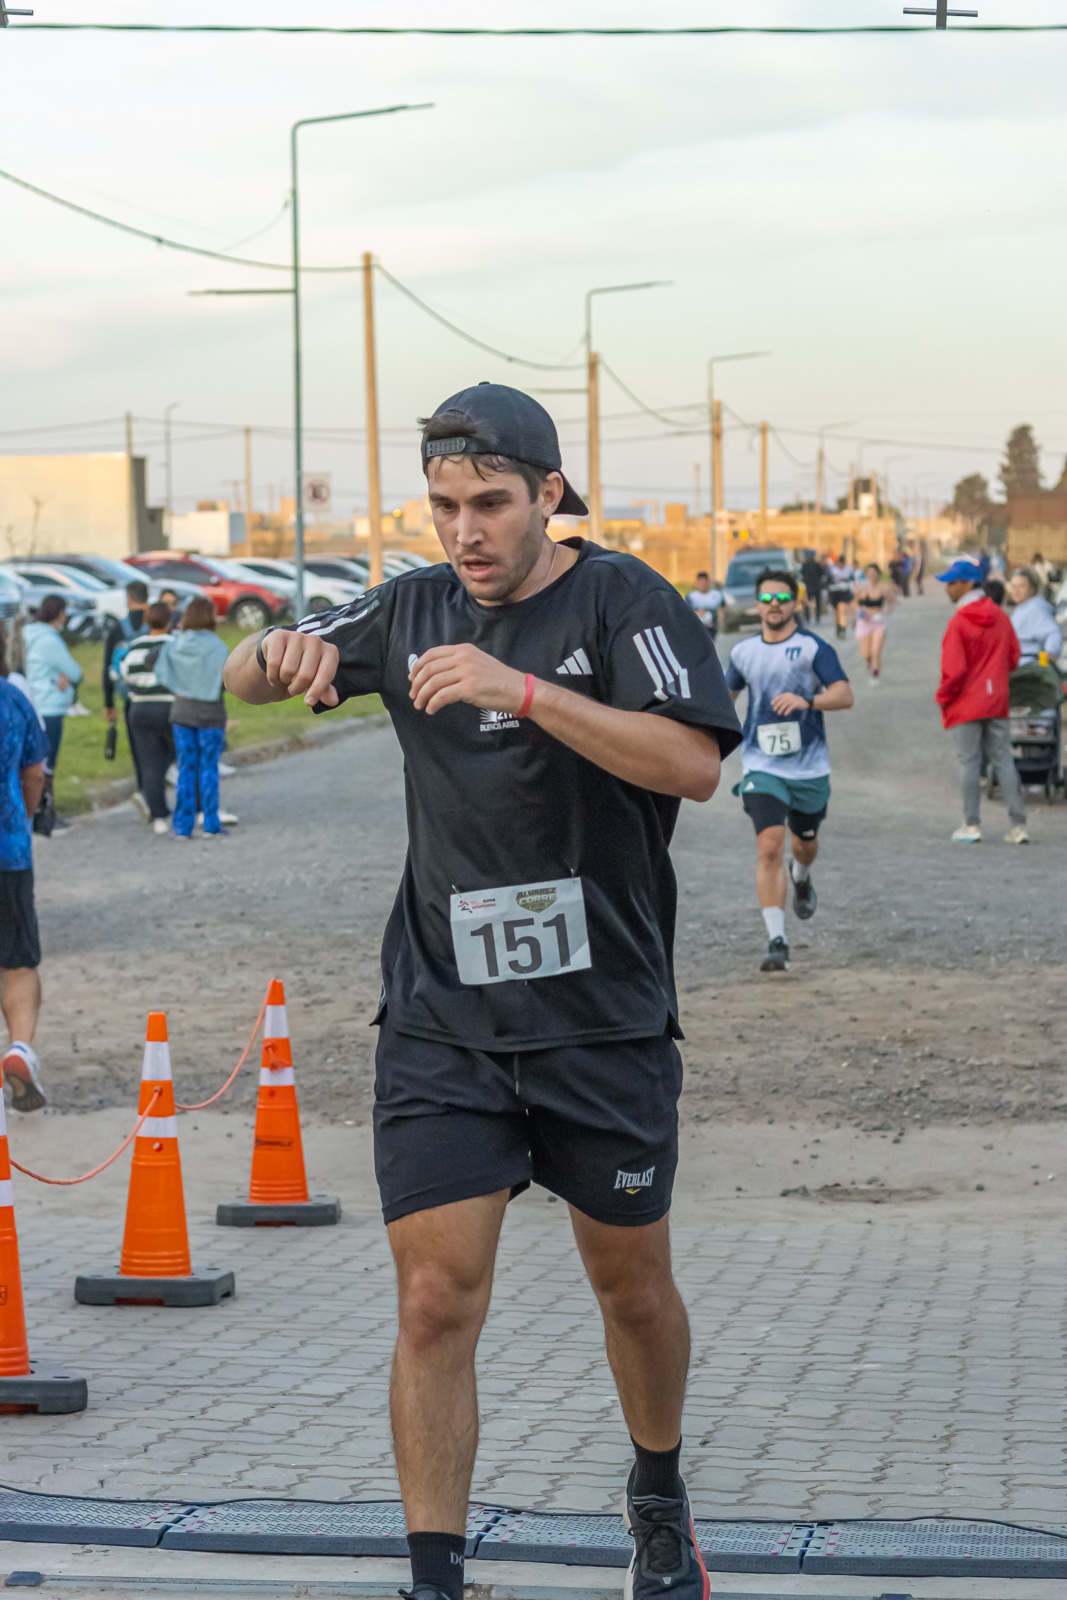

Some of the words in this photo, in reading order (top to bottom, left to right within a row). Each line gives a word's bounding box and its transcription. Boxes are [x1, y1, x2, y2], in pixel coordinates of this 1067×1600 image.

[480, 722, 501, 731] BUENOS
[502, 720, 519, 729] AIRES
[767, 733, 792, 752] 75
[516, 887, 557, 899] ALVAREZ
[518, 893, 557, 905] CORRE
[470, 912, 571, 978] 151
[613, 1166, 655, 1189] EVERLAST
